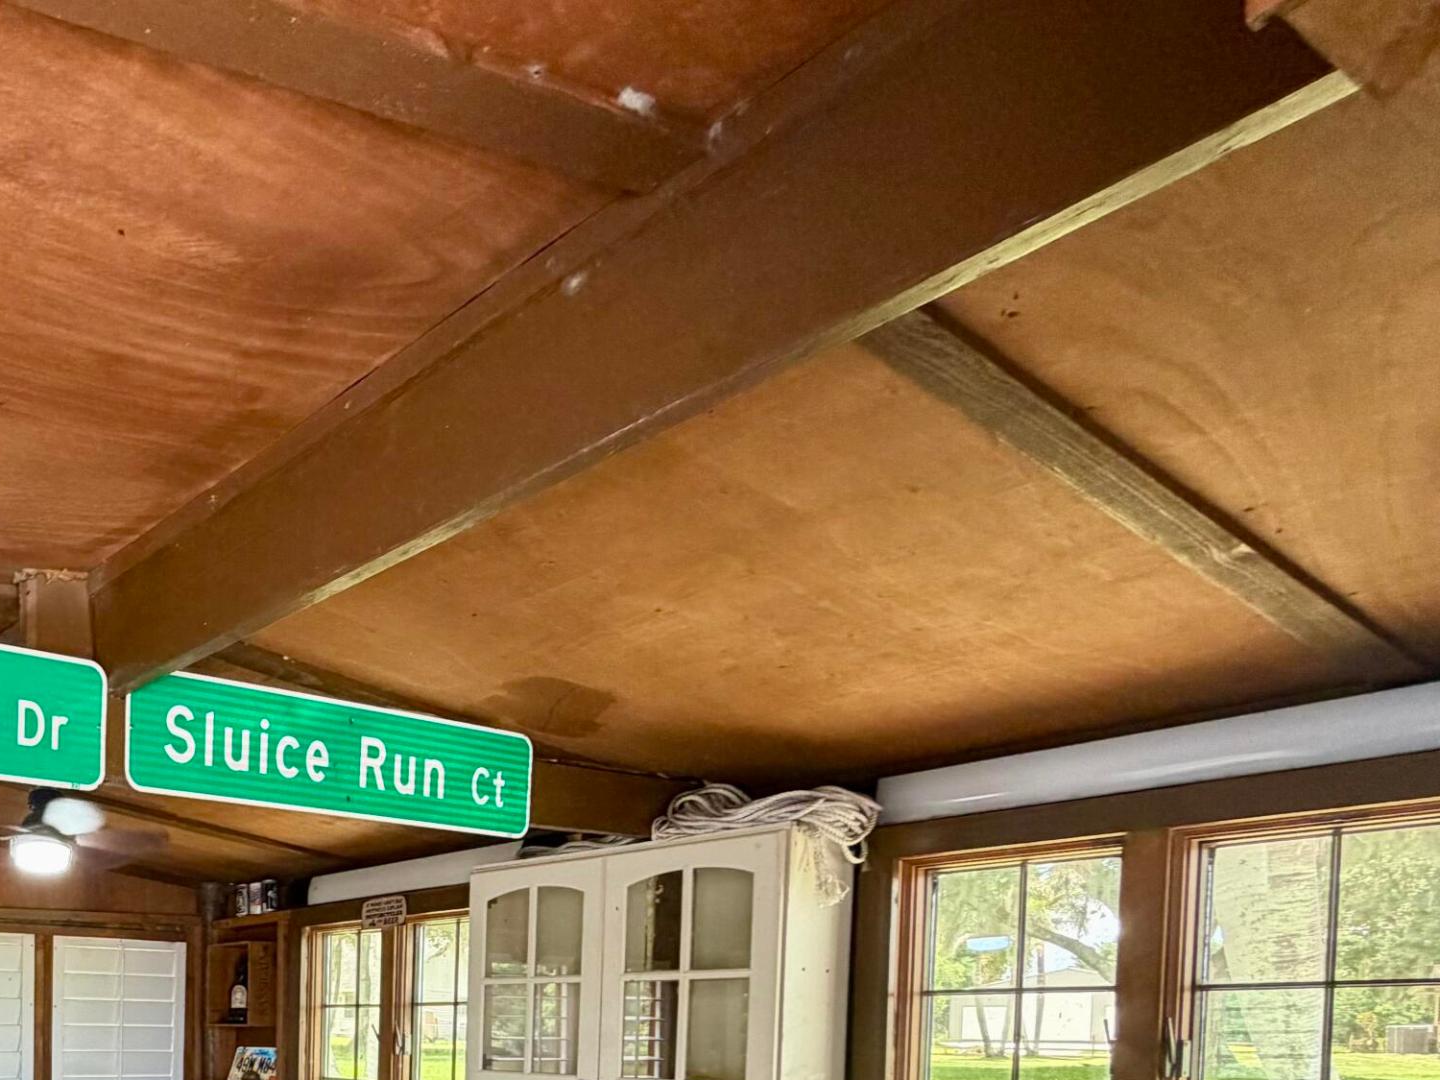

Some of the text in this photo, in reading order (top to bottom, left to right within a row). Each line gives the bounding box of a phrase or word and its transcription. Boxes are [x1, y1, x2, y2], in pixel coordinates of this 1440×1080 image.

[17, 699, 69, 750] Dr
[163, 704, 506, 808] Sluice Run Ct
